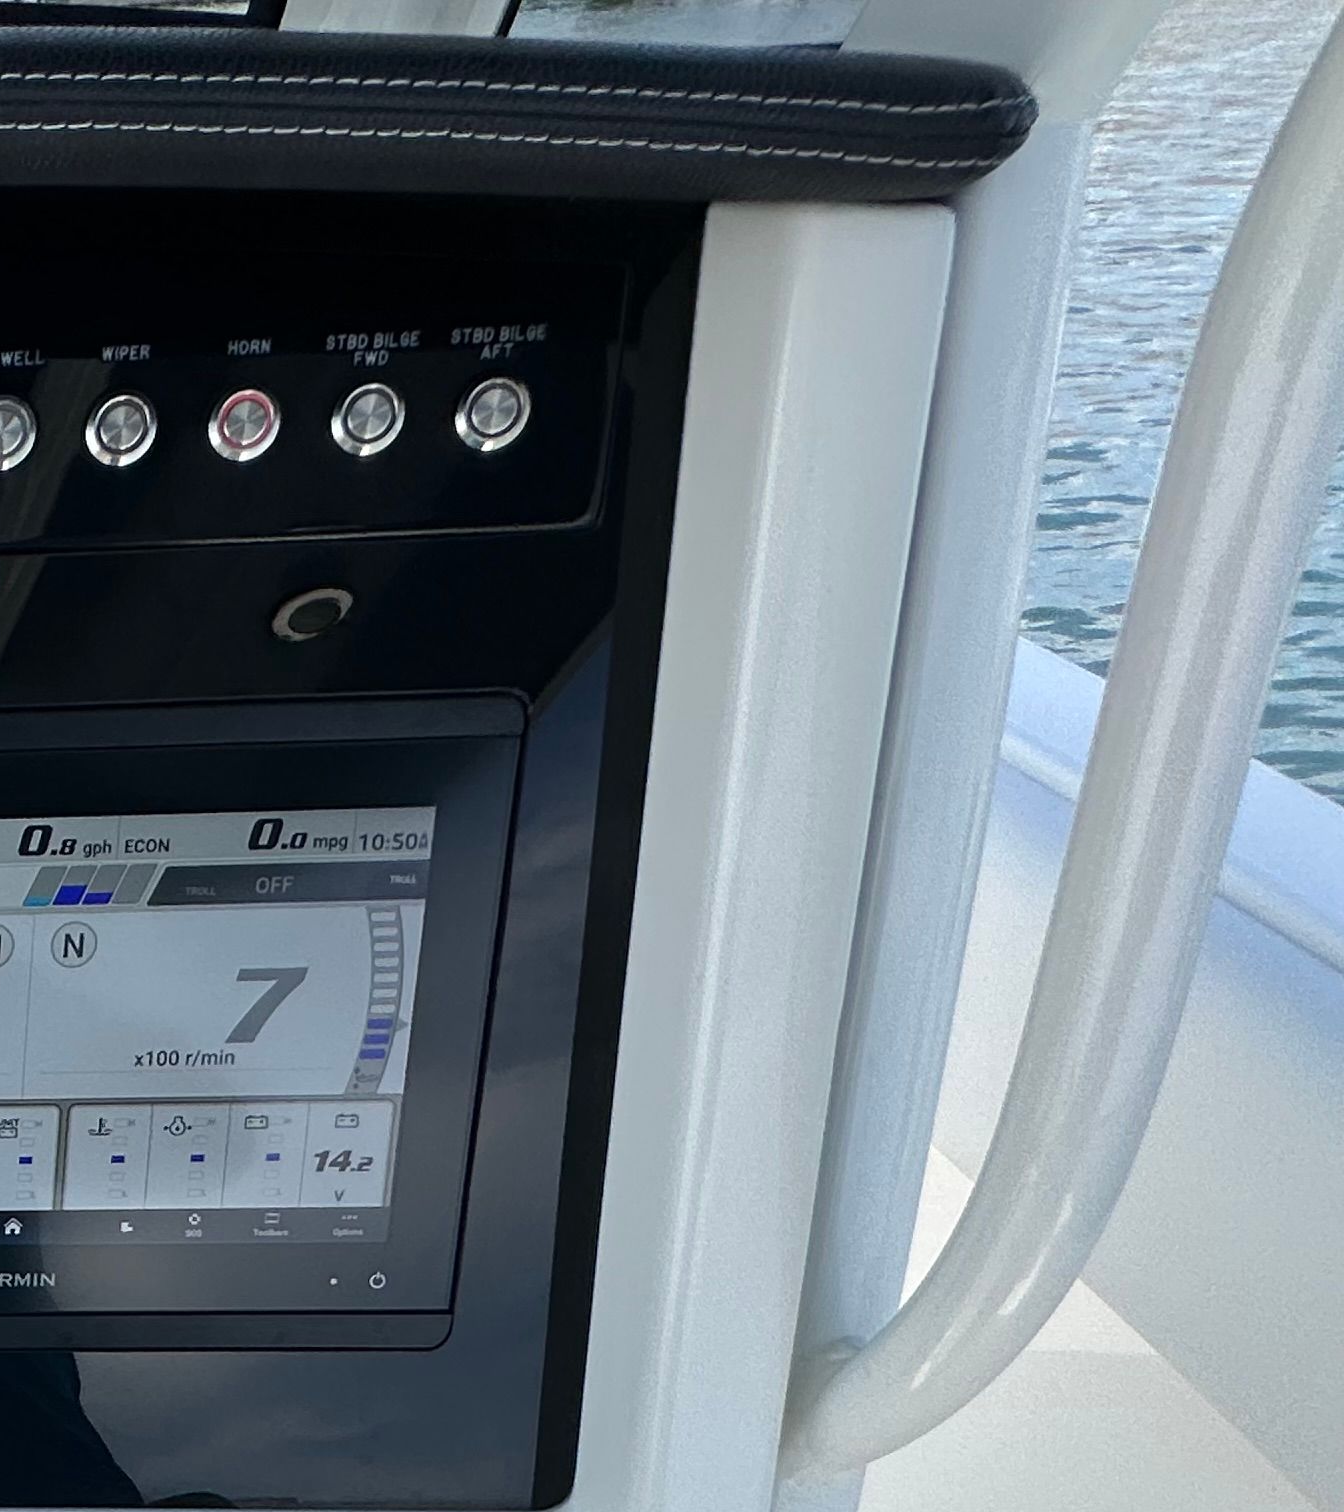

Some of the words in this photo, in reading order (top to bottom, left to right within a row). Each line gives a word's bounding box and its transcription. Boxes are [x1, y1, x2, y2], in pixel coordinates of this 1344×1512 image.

[326, 333, 370, 351] STBD
[374, 330, 421, 349] BILGE
[451, 326, 495, 344] STBD
[499, 323, 547, 342] BILGE
[102, 344, 151, 362] WIPER
[227, 338, 272, 356] HORN
[480, 343, 513, 360] AFT
[353, 350, 389, 367] FWD
[17, 824, 77, 857] 0.8
[82, 839, 112, 858] gph
[124, 838, 171, 854] ECON
[247, 817, 309, 851] 0.0
[313, 834, 349, 854] mpg
[255, 876, 295, 894] OFF
[62, 932, 85, 958] N
[224, 967, 310, 1045] 7
[133, 1050, 180, 1068] x100
[185, 1049, 236, 1068] r/min
[313, 1149, 374, 1172] 14.2
[334, 1189, 345, 1202] V
